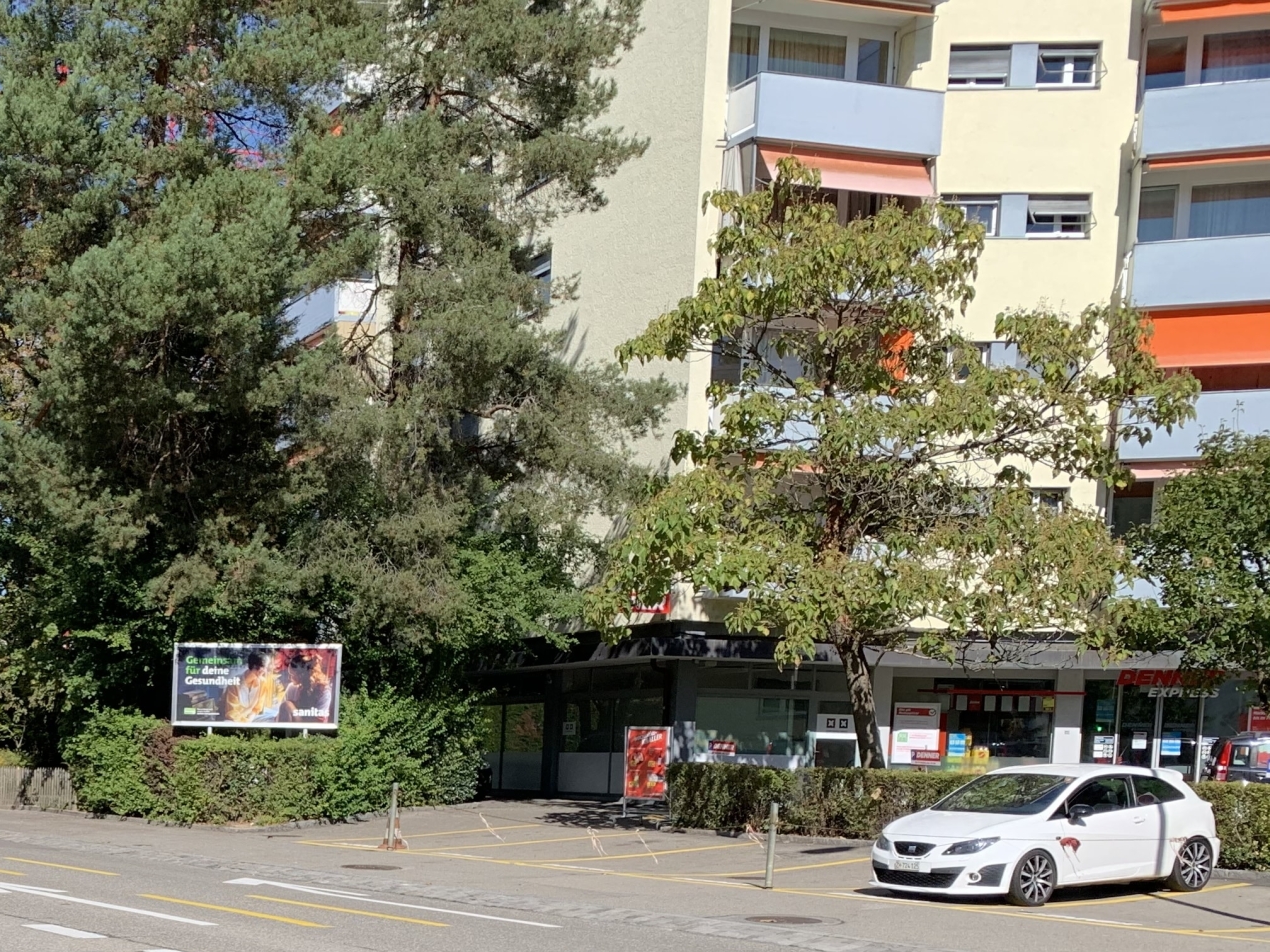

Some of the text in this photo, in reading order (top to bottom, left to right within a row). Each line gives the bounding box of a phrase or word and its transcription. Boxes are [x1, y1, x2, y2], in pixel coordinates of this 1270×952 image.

[185, 655, 243, 666] Gemeinsam
[185, 665, 230, 676] für deine
[184, 675, 241, 686] Gesundheit
[292, 706, 330, 718] sanitas
[916, 751, 940, 760] DENNER
